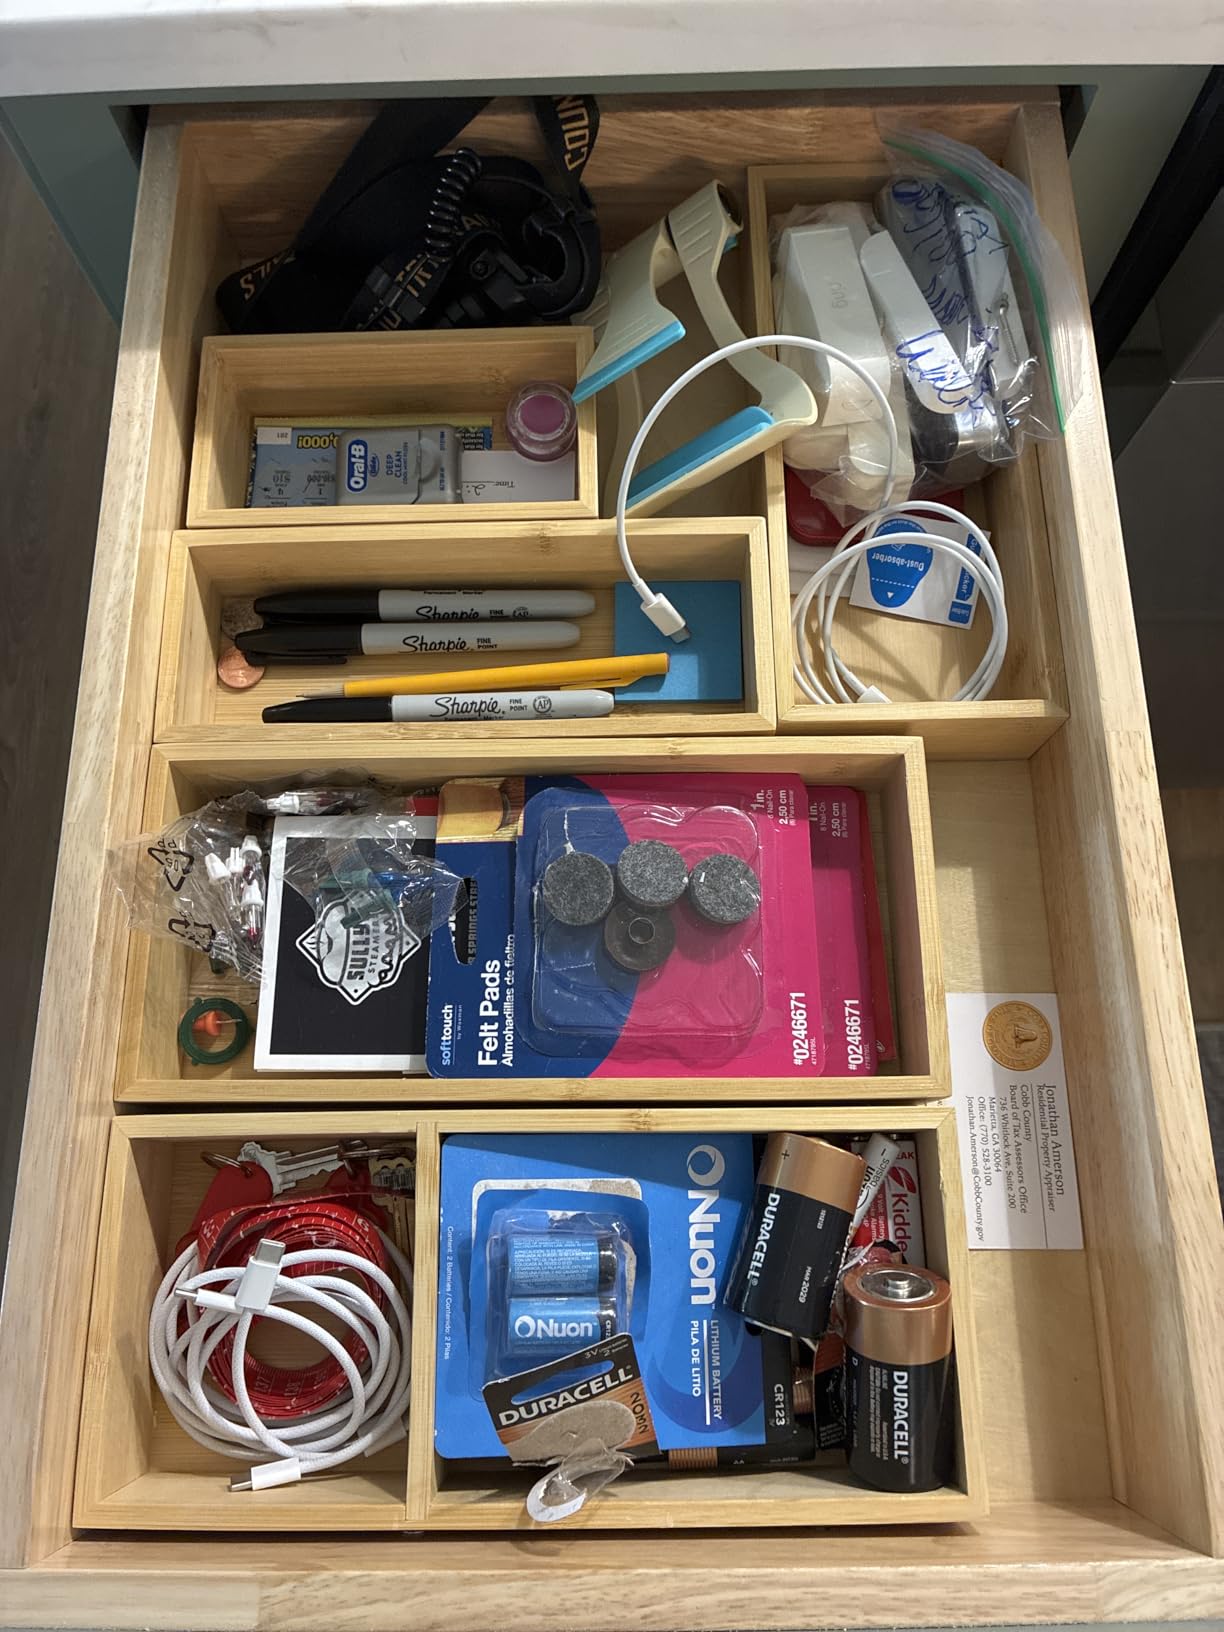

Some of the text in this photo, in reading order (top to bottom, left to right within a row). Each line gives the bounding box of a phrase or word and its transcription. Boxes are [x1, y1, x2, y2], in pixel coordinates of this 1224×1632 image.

[349, 444, 366, 489] Oral-B
[386, 454, 394, 476] DEEP
[394, 450, 402, 478] CLEAN
[871, 552, 925, 572] Dust-absorber
[400, 635, 470, 654] Sharpie
[429, 696, 502, 718] Sharpie
[778, 790, 787, 804] cm
[346, 924, 370, 980] SULLY
[503, 969, 515, 986] de
[439, 1004, 454, 1066] softtouch
[477, 959, 501, 1067] Felt Pads
[501, 987, 515, 1067] Almohadillas
[789, 992, 810, 1066] #0246671
[843, 999, 864, 1071] #0246671
[999, 1096, 1008, 1112] 736
[1009, 1084, 1020, 1110] Board
[1020, 1084, 1033, 1143] Cobb County
[977, 1096, 993, 1186] Office: (770) 528-3100
[988, 1096, 1002, 1173] Marietta, GA 30064
[1000, 1113, 1011, 1150] Whitlock
[1012, 1122, 1022, 1139] Tax
[1036, 1084, 1056, 1212] Residential Property Appraiser
[1043, 1083, 1065, 1196] Jonathan Amerson
[1006, 1170, 1015, 1192] Suite
[1014, 1139, 1026, 1184] Assessors
[1008, 1193, 1016, 1209] 200
[1018, 1186, 1028, 1214] Office
[748, 1192, 780, 1280] DURACELL
[891, 1192, 912, 1254] Kidde
[798, 1281, 810, 1303] 2029
[690, 1320, 702, 1397] PILA DE LITIO
[710, 1319, 722, 1420] LITHIUM BATTERY
[498, 1367, 634, 1426] DURACELL
[774, 1383, 786, 1426] CR123
[893, 1370, 909, 1460] DURACELL
